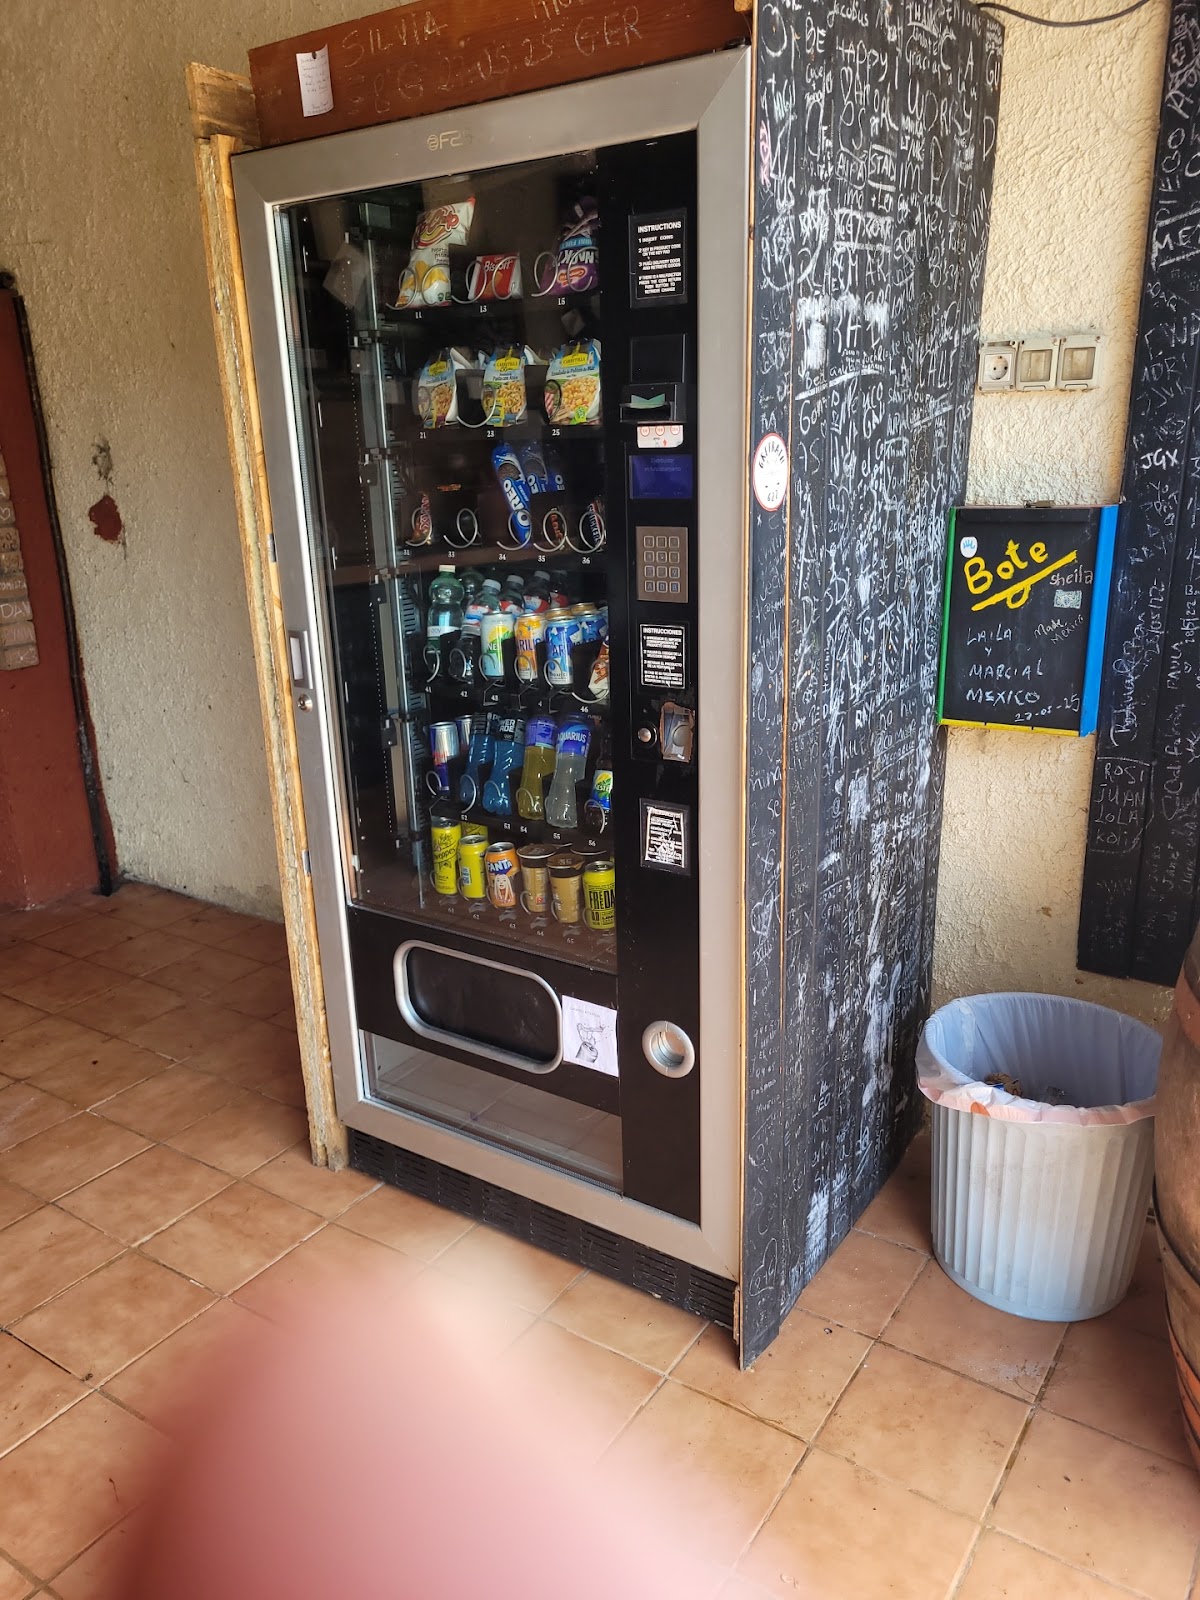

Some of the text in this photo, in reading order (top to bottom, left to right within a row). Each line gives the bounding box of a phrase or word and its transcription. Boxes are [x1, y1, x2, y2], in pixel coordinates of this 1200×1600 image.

[342, 11, 447, 67] SILVIA
[638, 221, 681, 233] INSTRUCTIONS
[557, 298, 566, 306] 15
[479, 305, 487, 313] 13
[419, 431, 427, 439] 21
[486, 430, 495, 438] 23
[552, 428, 561, 437] 25
[447, 550, 455, 558] 33
[538, 555, 546, 563] 35
[582, 557, 590, 565] 36
[964, 539, 1049, 594] Bote
[642, 627, 682, 635] INSTRUCCIONES
[966, 623, 1012, 645] LAILA
[969, 658, 1043, 680] MARCIAL
[460, 690, 468, 698] 42
[966, 687, 1040, 706] MEXICO
[580, 706, 589, 714] 46
